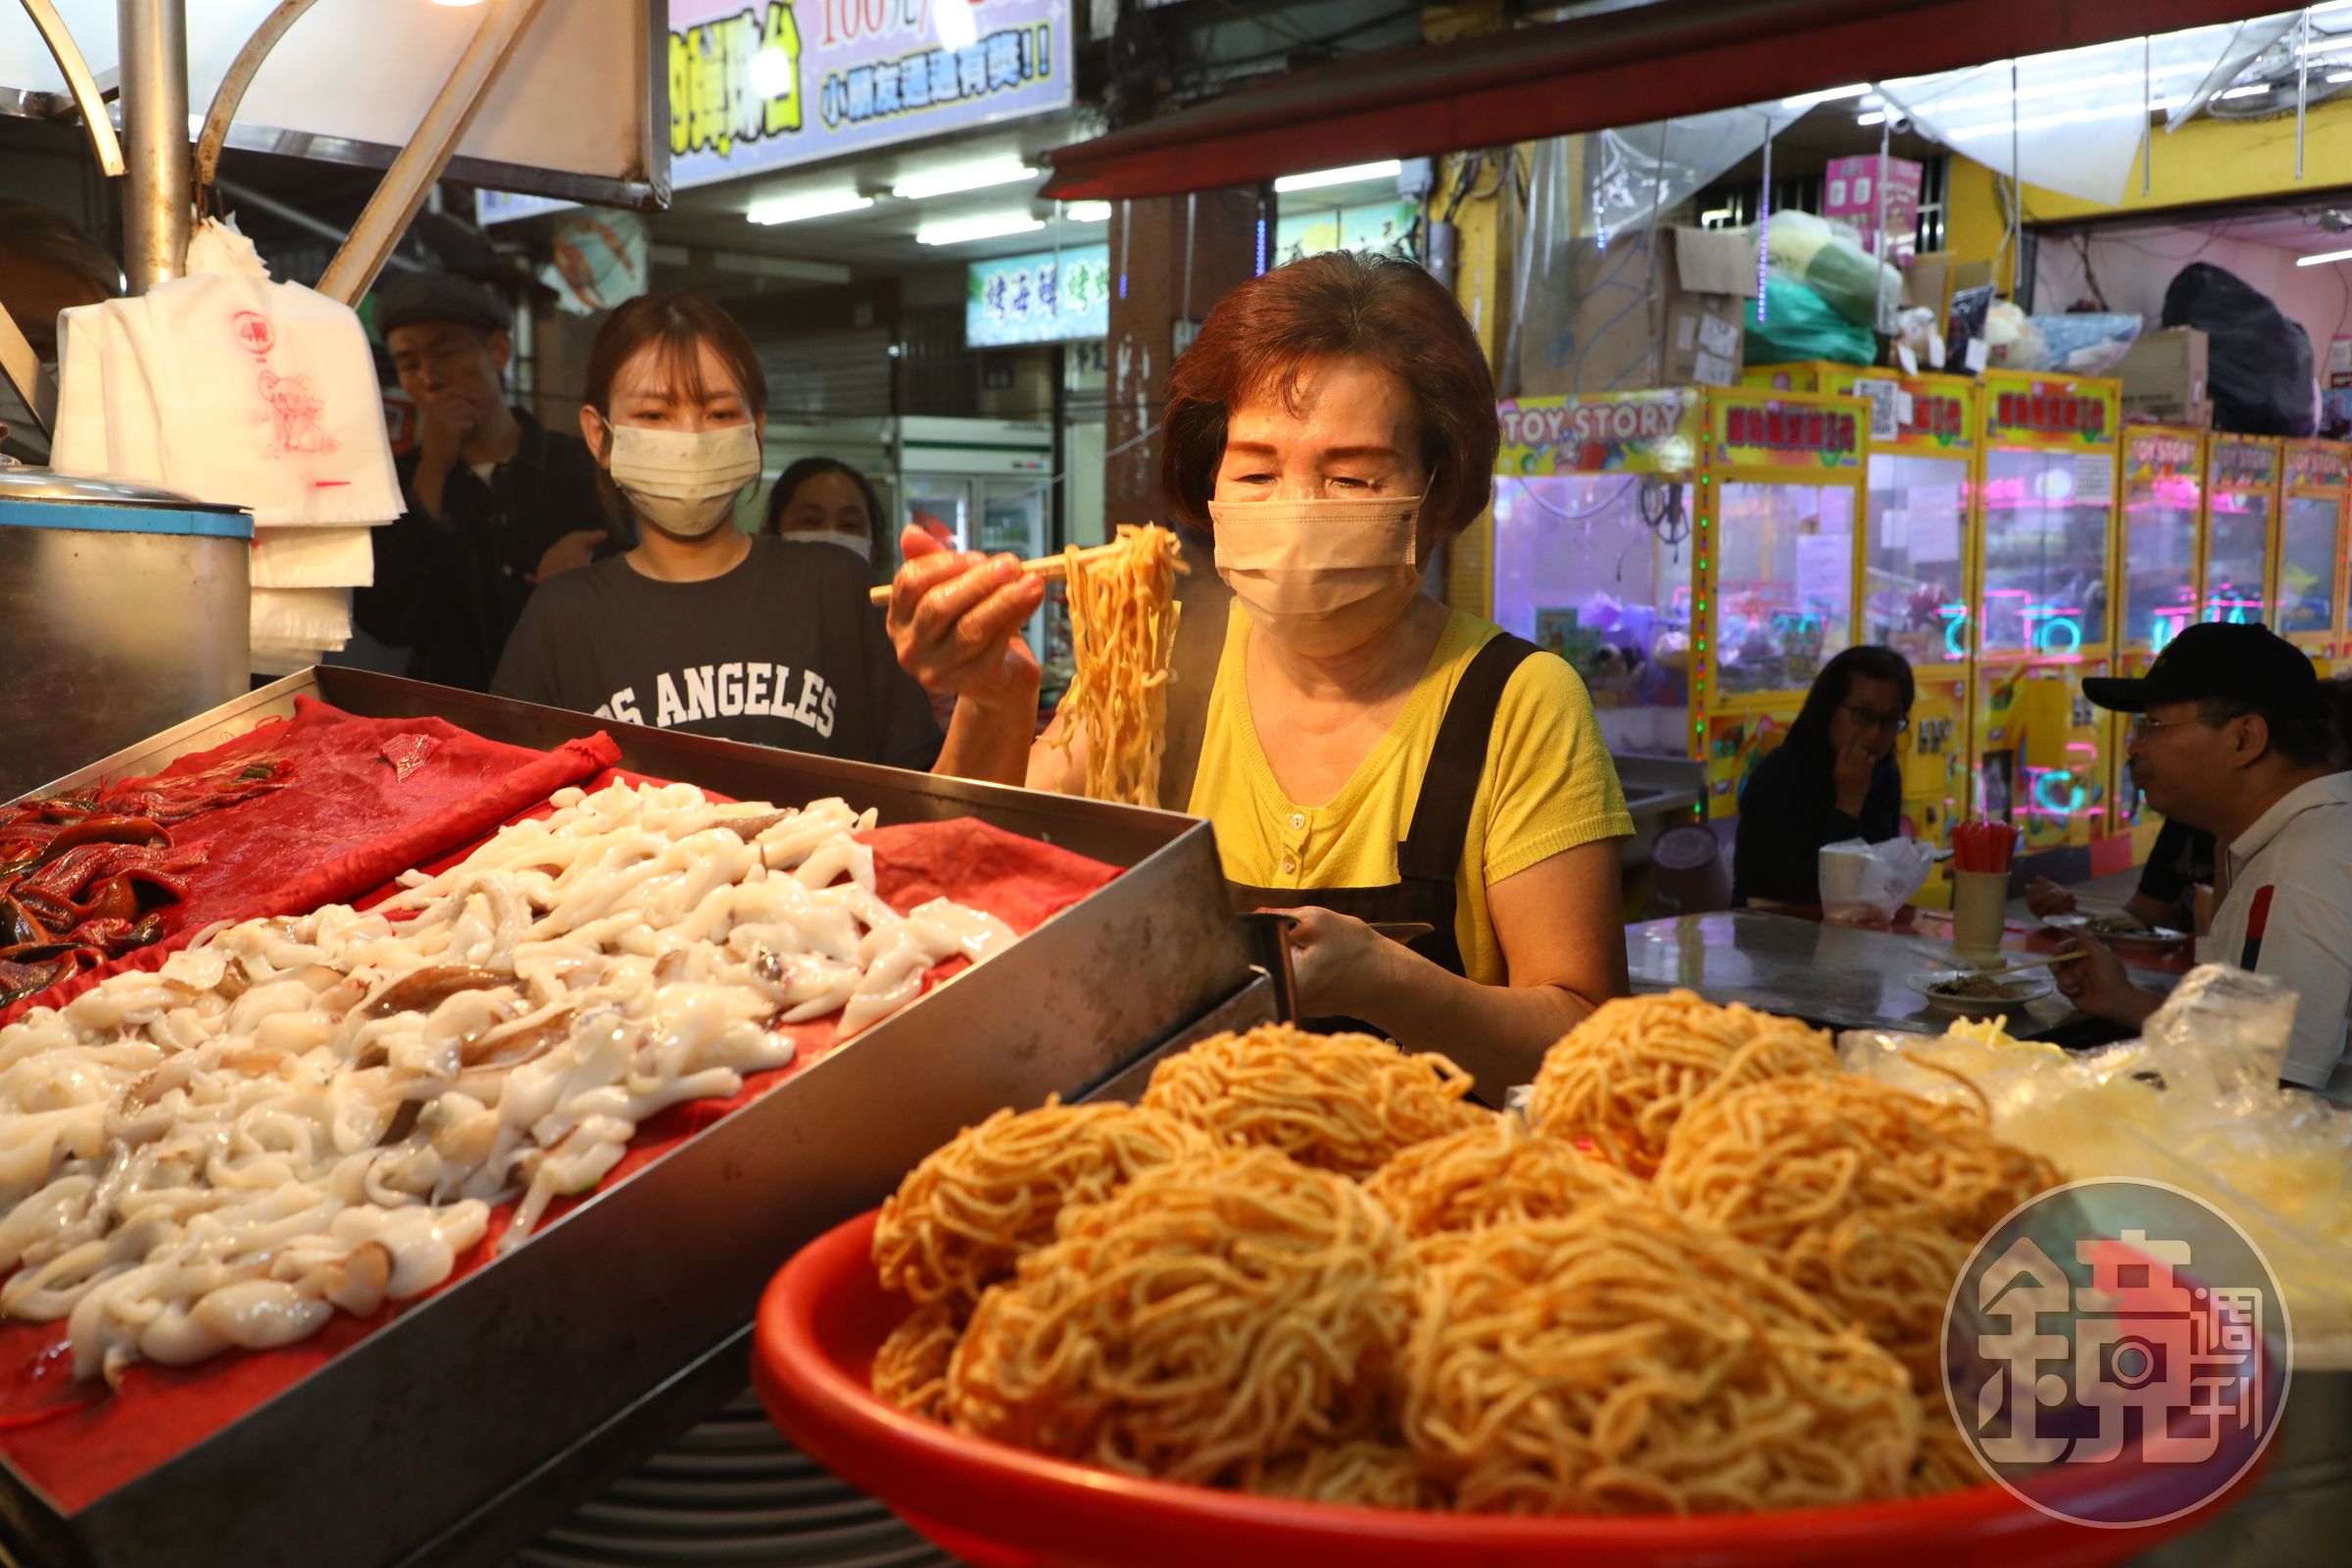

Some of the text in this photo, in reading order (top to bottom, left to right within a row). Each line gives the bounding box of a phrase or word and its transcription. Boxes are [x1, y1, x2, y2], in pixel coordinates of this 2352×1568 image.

[1501, 408, 1567, 445] TOY
[1571, 400, 1685, 443] STORY
[657, 662, 837, 738] ANGELES
